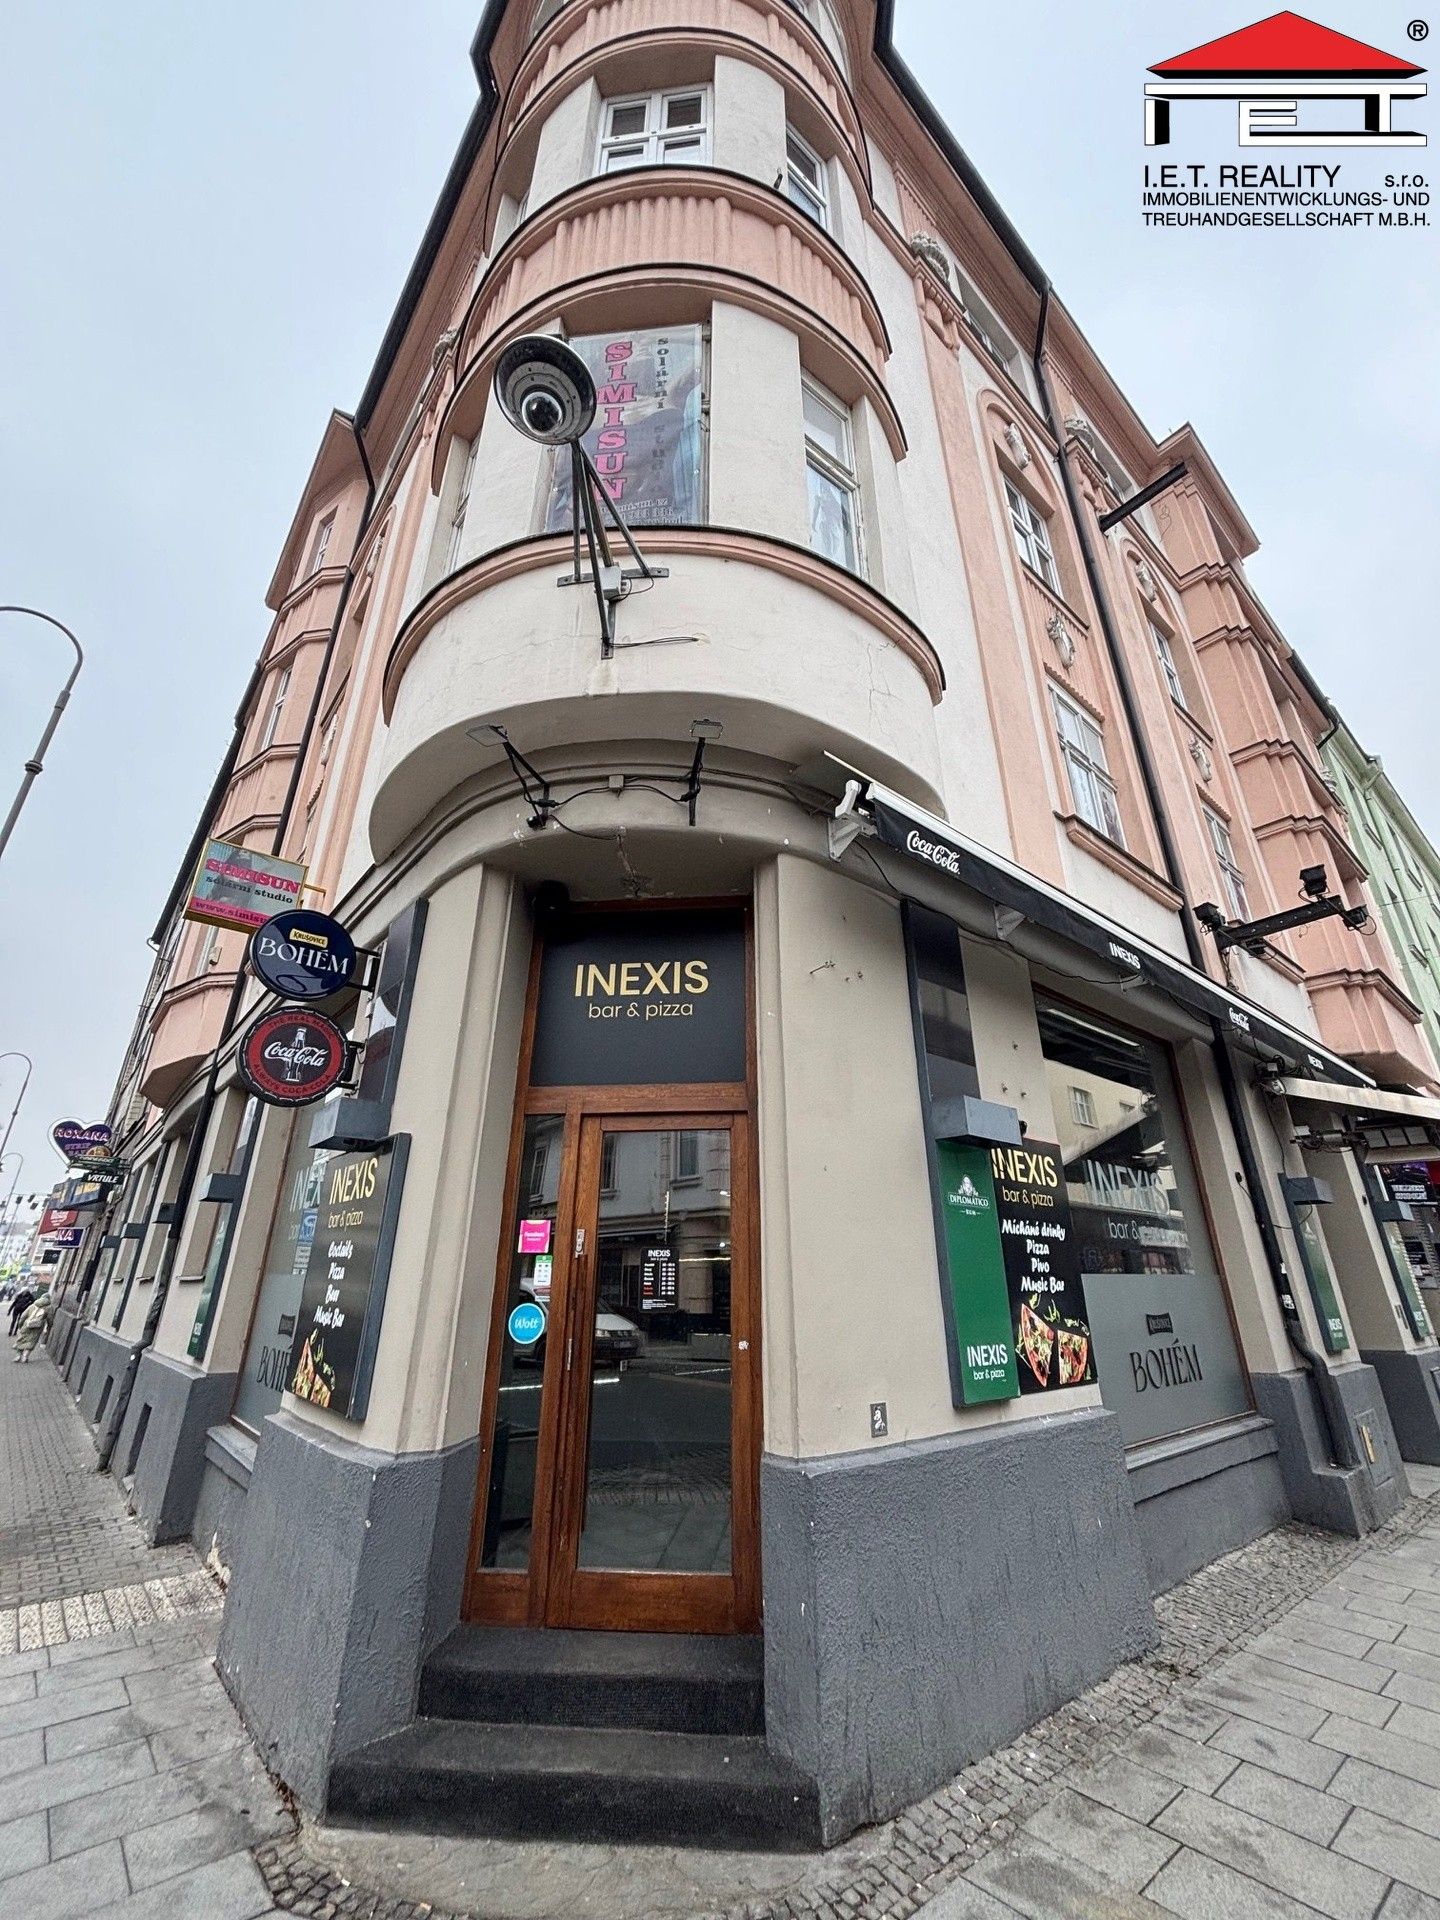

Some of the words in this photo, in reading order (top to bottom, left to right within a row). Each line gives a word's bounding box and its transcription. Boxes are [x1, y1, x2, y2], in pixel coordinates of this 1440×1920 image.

[594, 341, 638, 500] SIMISUN
[206, 858, 301, 894] SIMISUN
[254, 888, 293, 904] studio
[259, 937, 349, 975] BOHÉM
[1108, 942, 1140, 970] INEXIS
[575, 960, 709, 997] INEXIS
[588, 1002, 623, 1018] bar
[626, 1002, 640, 1017] &
[645, 1001, 693, 1020] pizza
[87, 1174, 119, 1184] VRTULE
[991, 1148, 1058, 1188] INEXIS
[329, 1157, 378, 1205] INEXIS
[1002, 1186, 1020, 1203] bar
[1022, 1188, 1031, 1204] &
[1031, 1190, 1054, 1209] pizza
[328, 1212, 340, 1229] bar
[345, 1208, 364, 1232] pizza
[1001, 1218, 1040, 1237] Míchané
[1041, 1221, 1066, 1241] drinky
[1108, 1217, 1130, 1240] bar
[648, 1249, 671, 1257] INEXIS
[1026, 1238, 1050, 1256] Pizza
[328, 1262, 346, 1280] Pizza
[1031, 1257, 1050, 1274] Pivo
[1020, 1275, 1049, 1294] Music
[1049, 1276, 1065, 1295] Bar
[514, 1317, 539, 1330] Wolt
[967, 1344, 1009, 1368] INEXIS
[1129, 1338, 1203, 1393] BOHÉM
[973, 1369, 986, 1380] bar
[990, 1368, 1005, 1381] pizza
